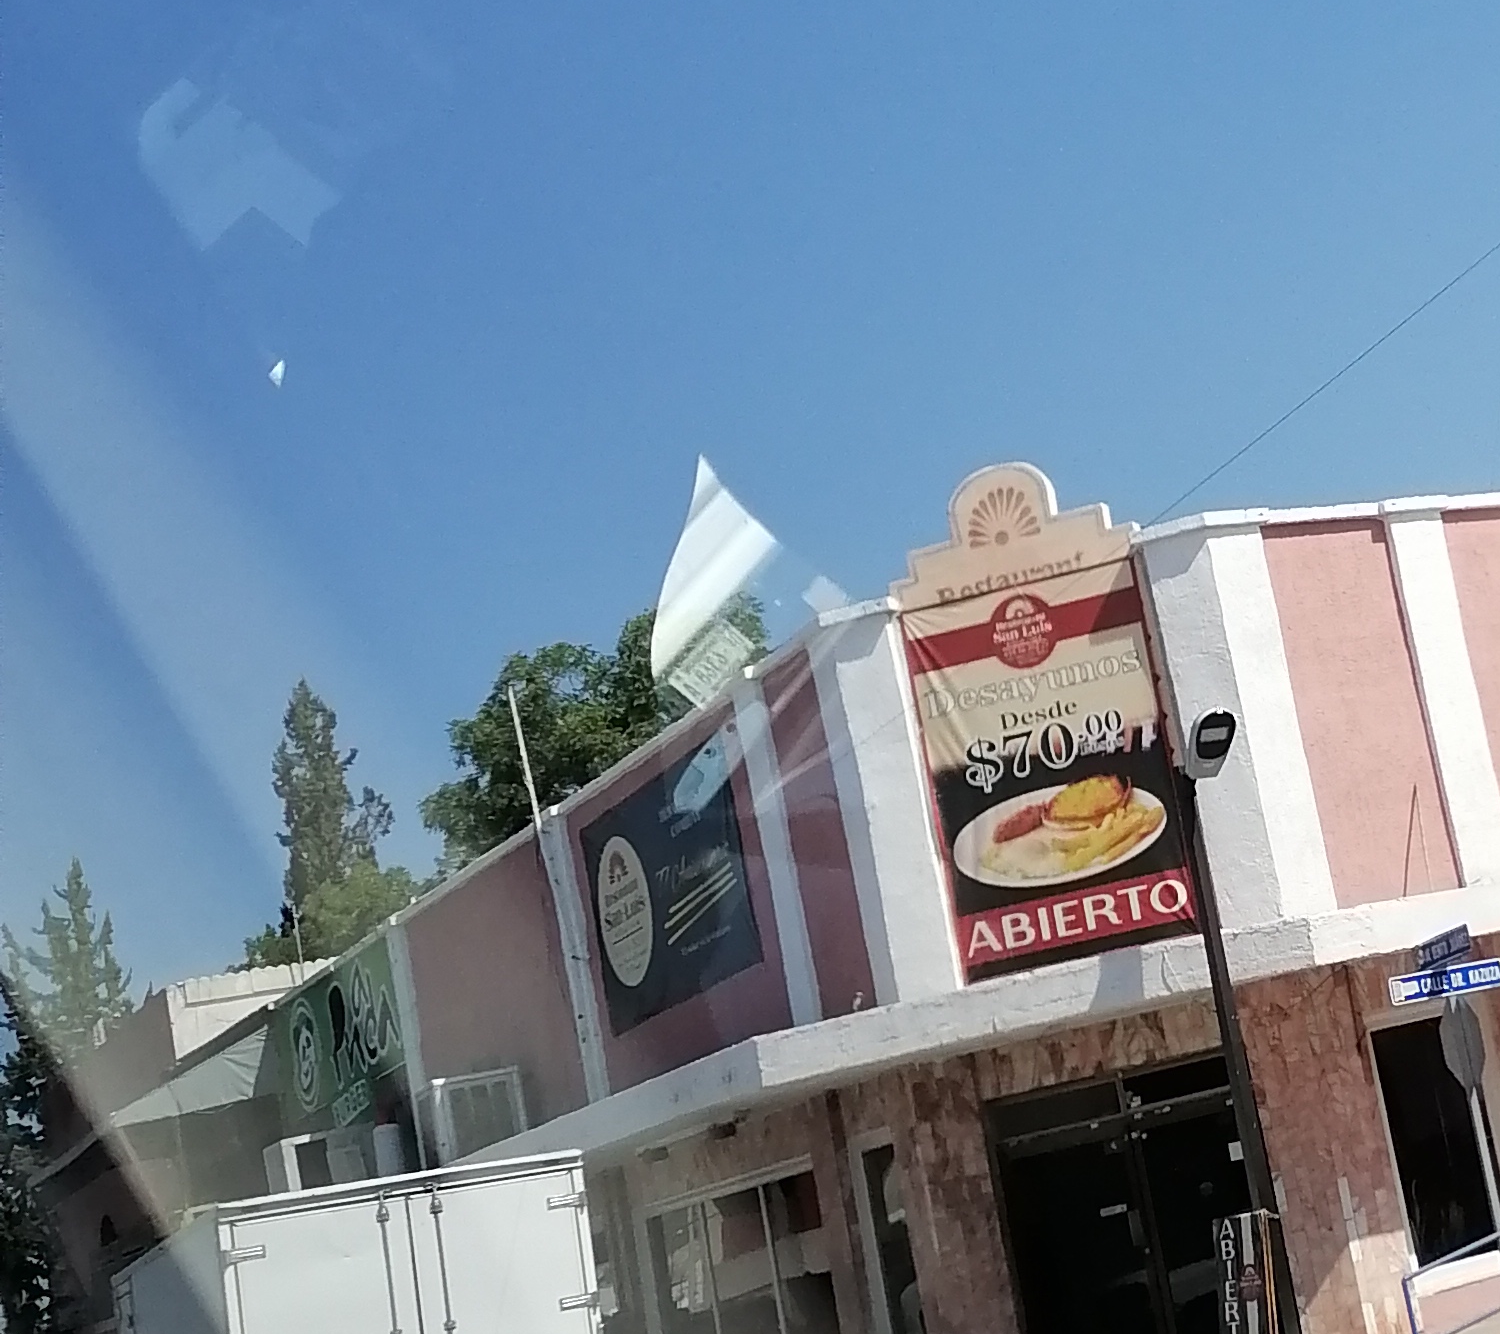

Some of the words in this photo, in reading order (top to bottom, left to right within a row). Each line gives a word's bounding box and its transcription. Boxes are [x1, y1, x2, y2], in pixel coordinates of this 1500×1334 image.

[925, 649, 1143, 719] Desayunos
[1000, 699, 1078, 731] Desde
[967, 878, 1188, 959] ABIERTO
